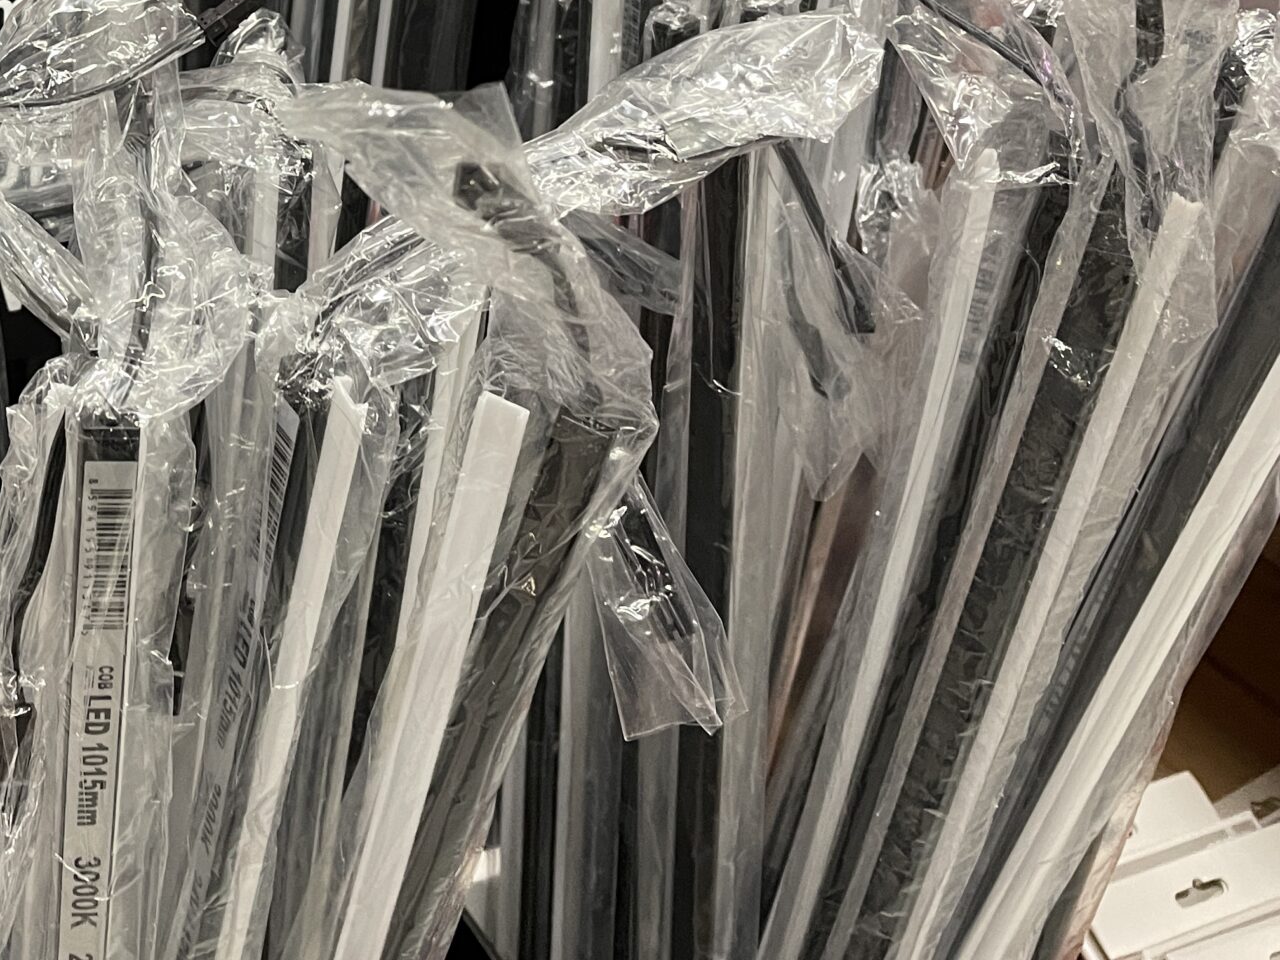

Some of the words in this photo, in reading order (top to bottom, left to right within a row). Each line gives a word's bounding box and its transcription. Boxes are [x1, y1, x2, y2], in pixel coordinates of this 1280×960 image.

[97, 665, 114, 689] COB
[84, 695, 112, 735] LED
[77, 743, 109, 826] 1015mm
[70, 856, 101, 929] 3000K
